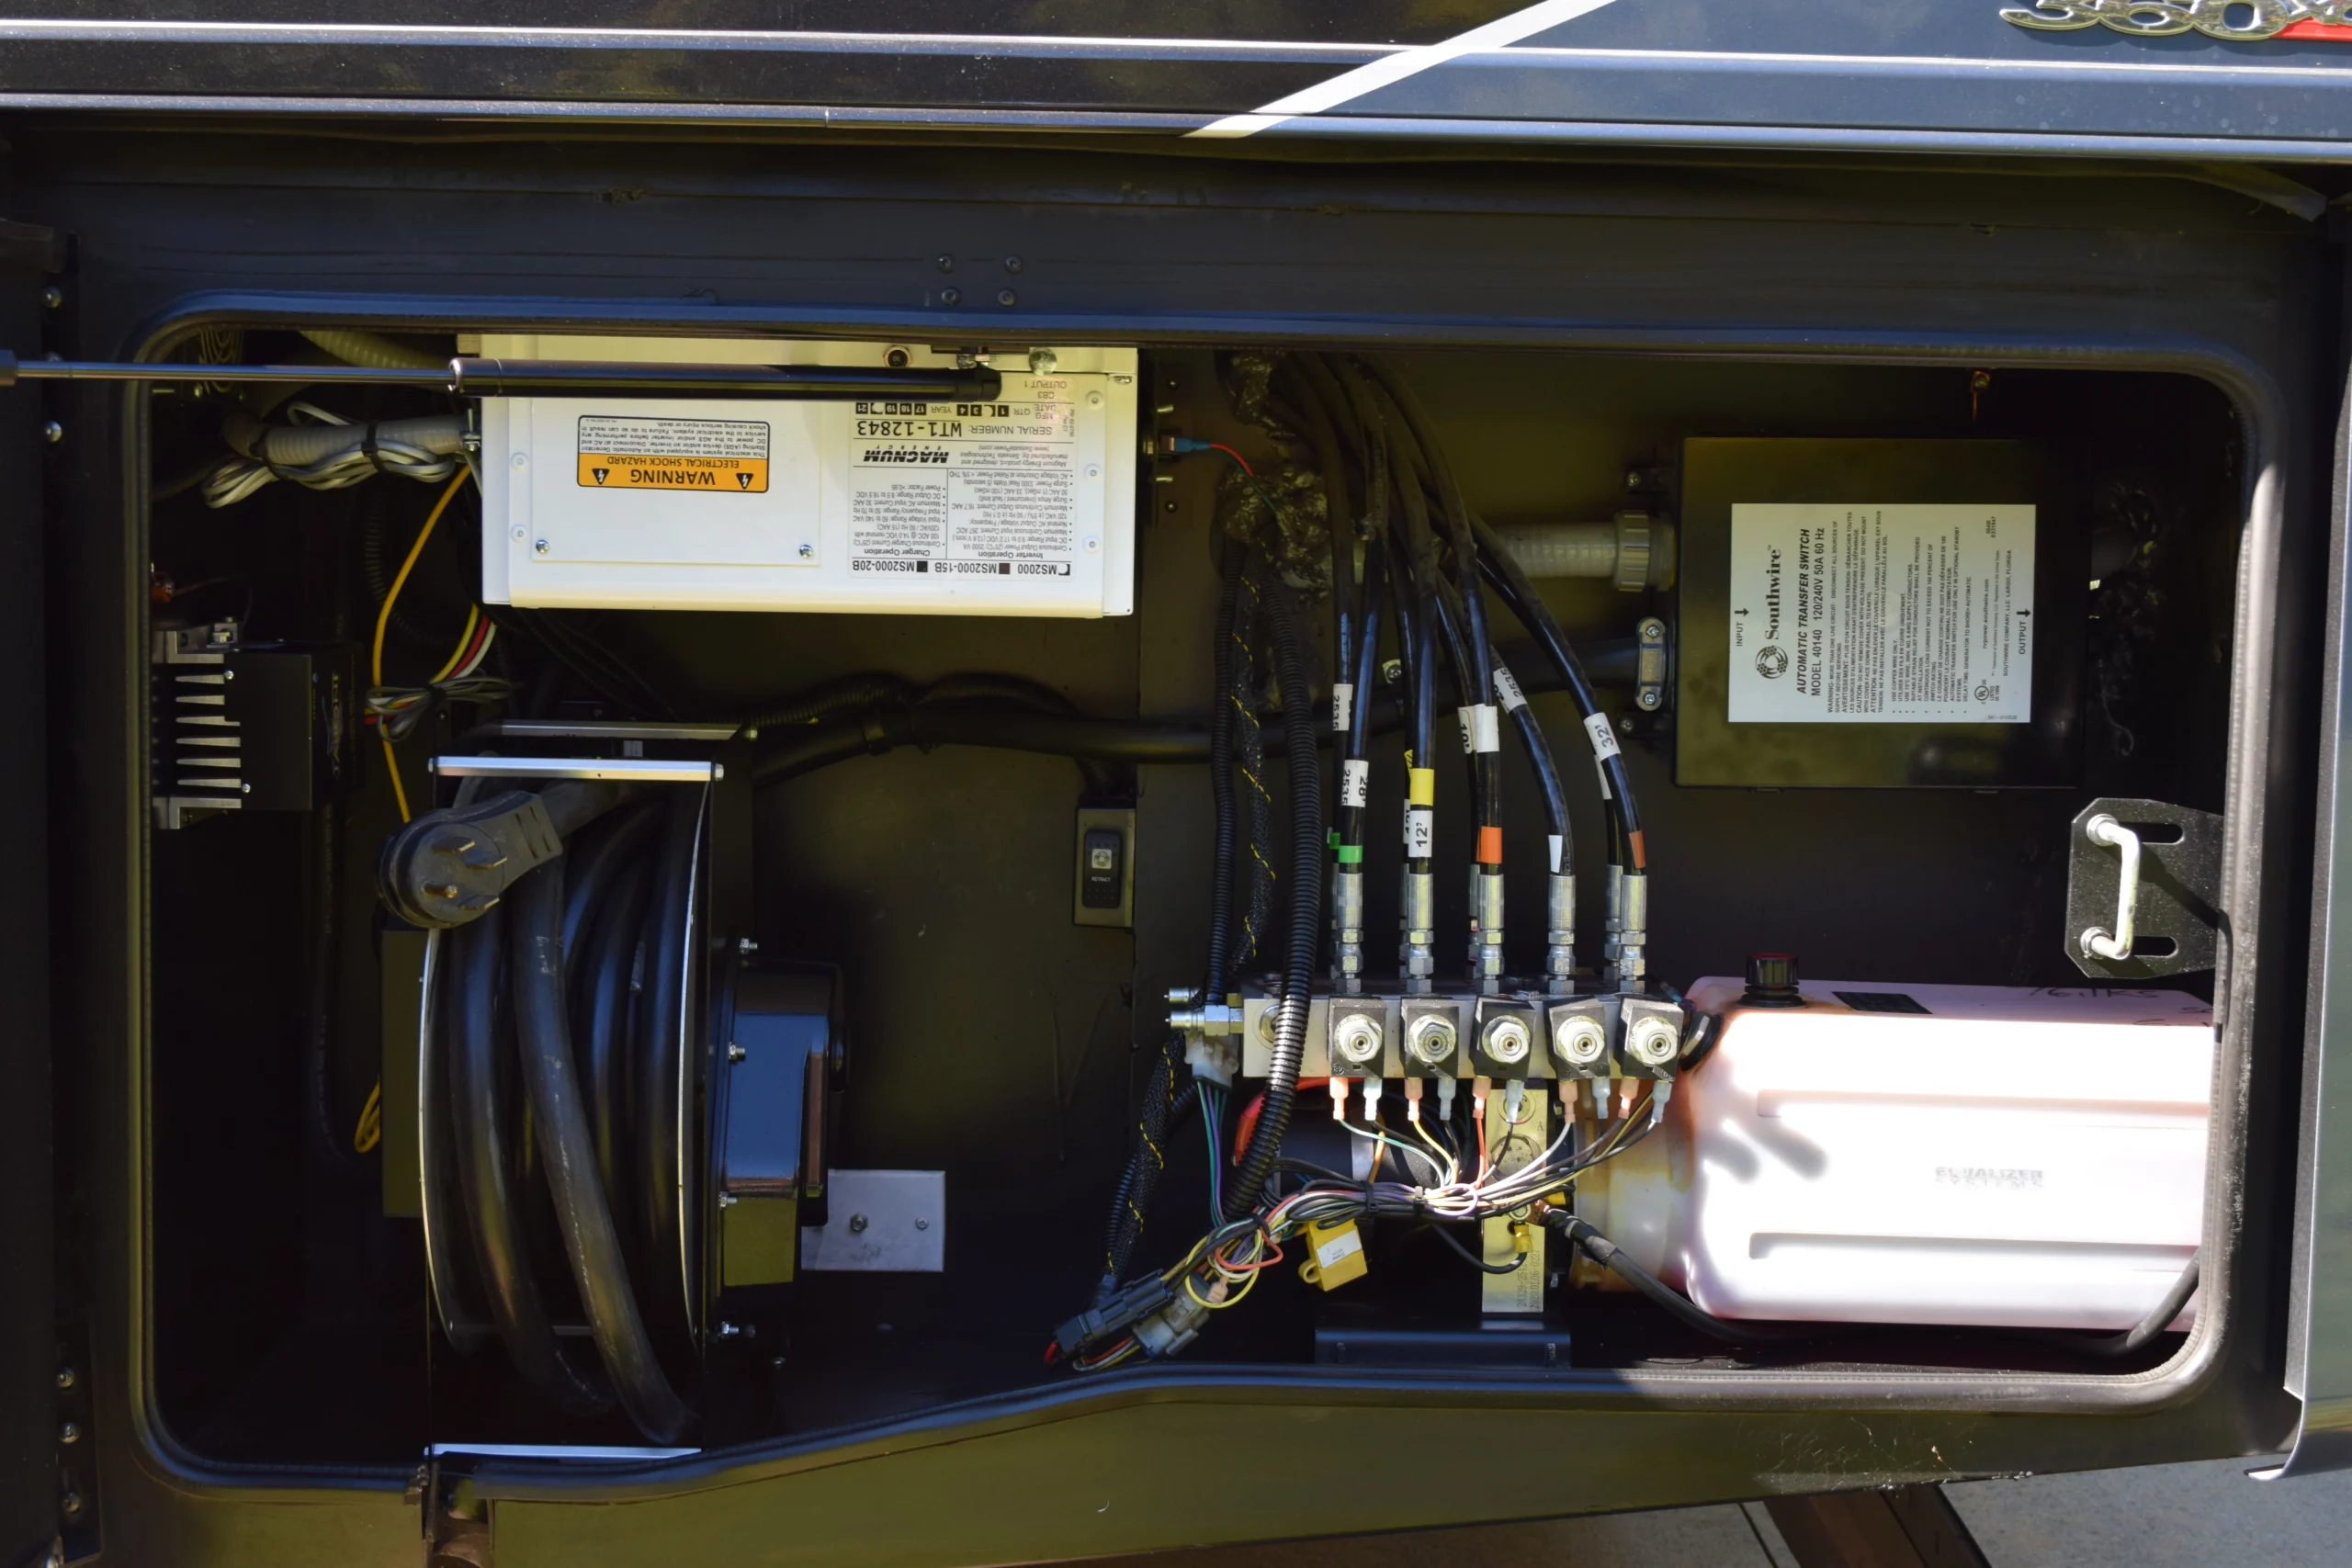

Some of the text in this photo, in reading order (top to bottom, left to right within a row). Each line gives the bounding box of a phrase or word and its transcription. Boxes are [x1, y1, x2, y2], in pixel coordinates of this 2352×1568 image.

[1030, 380, 1067, 389] OUTPUT
[1036, 390, 1054, 399] CB3
[856, 420, 1052, 436] SERIAL NUMBER: WT1-12843
[606, 456, 739, 468] ELECTRICAL SHOCK HAZARD
[863, 449, 948, 463] MAGNUM
[630, 468, 715, 485] WARNING
[901, 547, 930, 556] Charger
[852, 559, 1056, 574] MS2000 MS2000-15B MS2000-20B
[1765, 549, 1781, 639] Southwire
[1796, 528, 1809, 694] AUTOMATIC TRANSFER SWITCH
[1811, 527, 1824, 695] MODEL 40140 120/240V 50A 60 Hz
[1594, 724, 1614, 748] 32'
[1416, 822, 1428, 848] 12'
